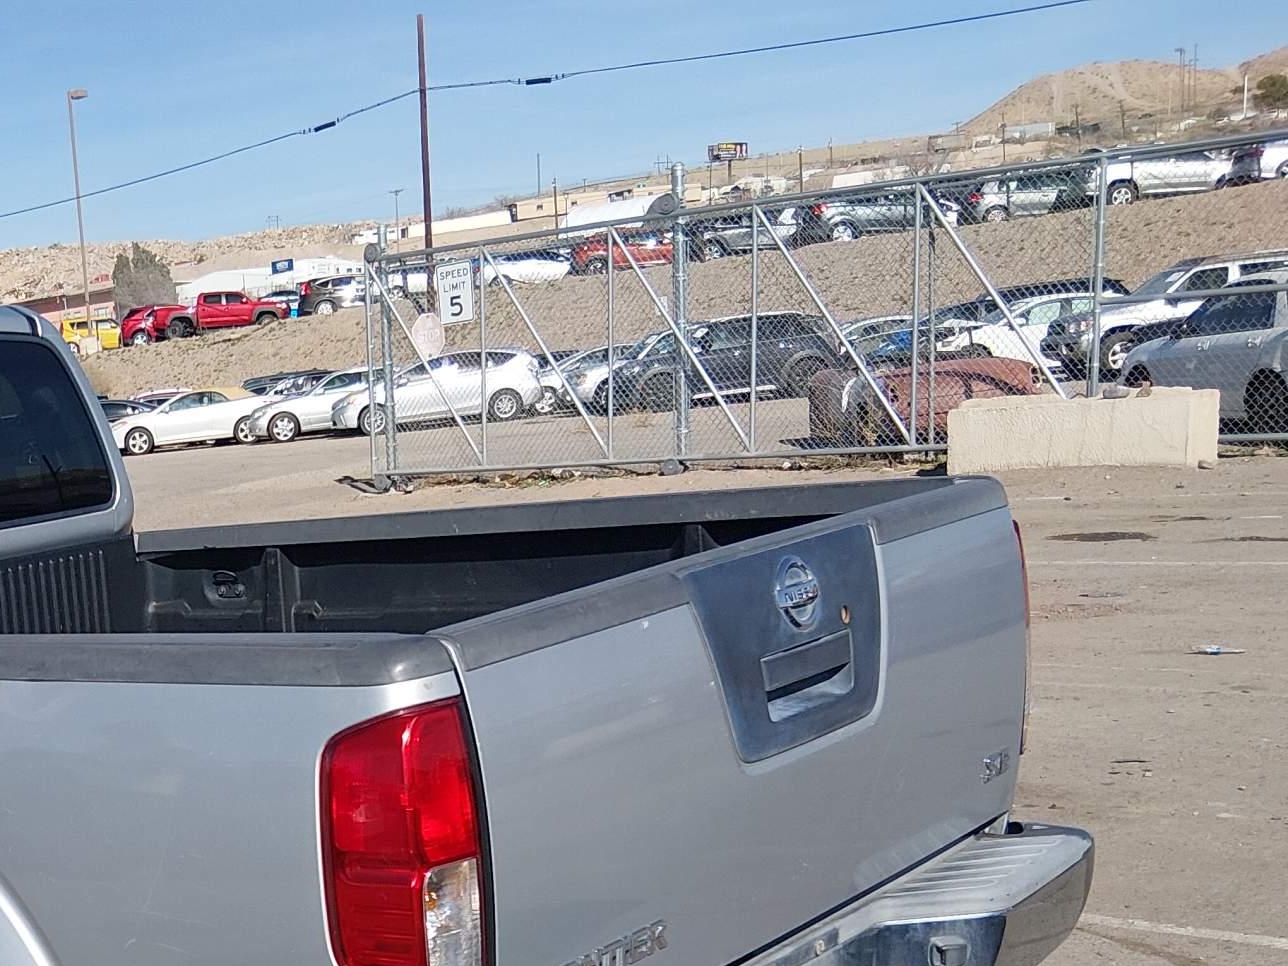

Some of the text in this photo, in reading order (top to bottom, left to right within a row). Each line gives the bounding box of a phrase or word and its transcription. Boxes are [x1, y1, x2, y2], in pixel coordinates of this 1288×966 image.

[439, 267, 469, 281] SPEED
[443, 281, 466, 293] LIMIT
[450, 295, 463, 317] 5
